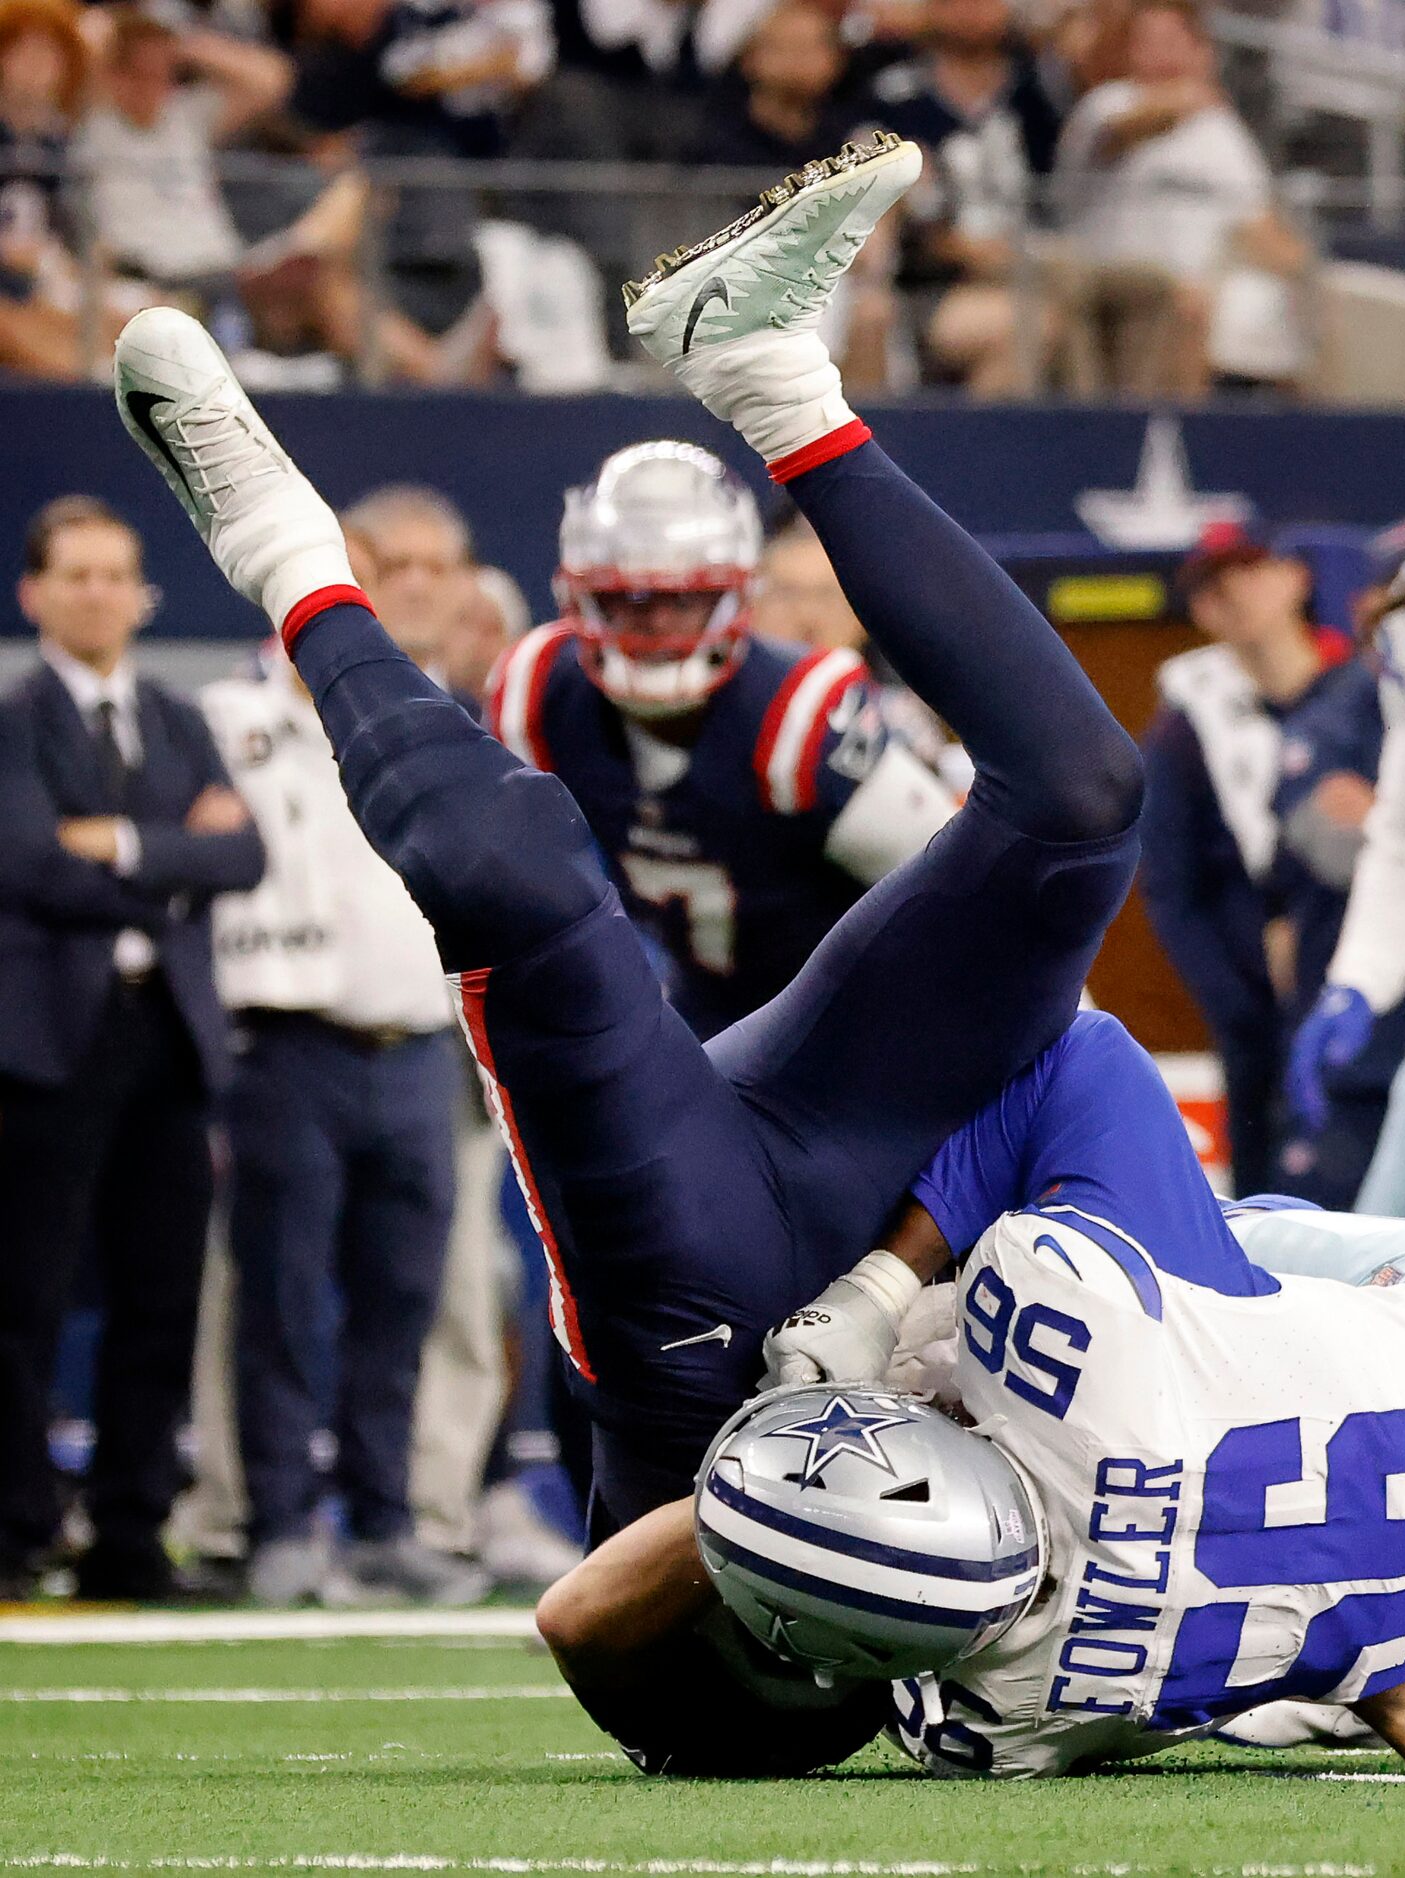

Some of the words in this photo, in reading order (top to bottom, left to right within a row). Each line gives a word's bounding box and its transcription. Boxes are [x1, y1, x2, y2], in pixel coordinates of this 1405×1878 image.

[620, 853, 738, 977] 7
[964, 1265, 1092, 1421] 56
[1045, 1456, 1184, 1714] FOWLER
